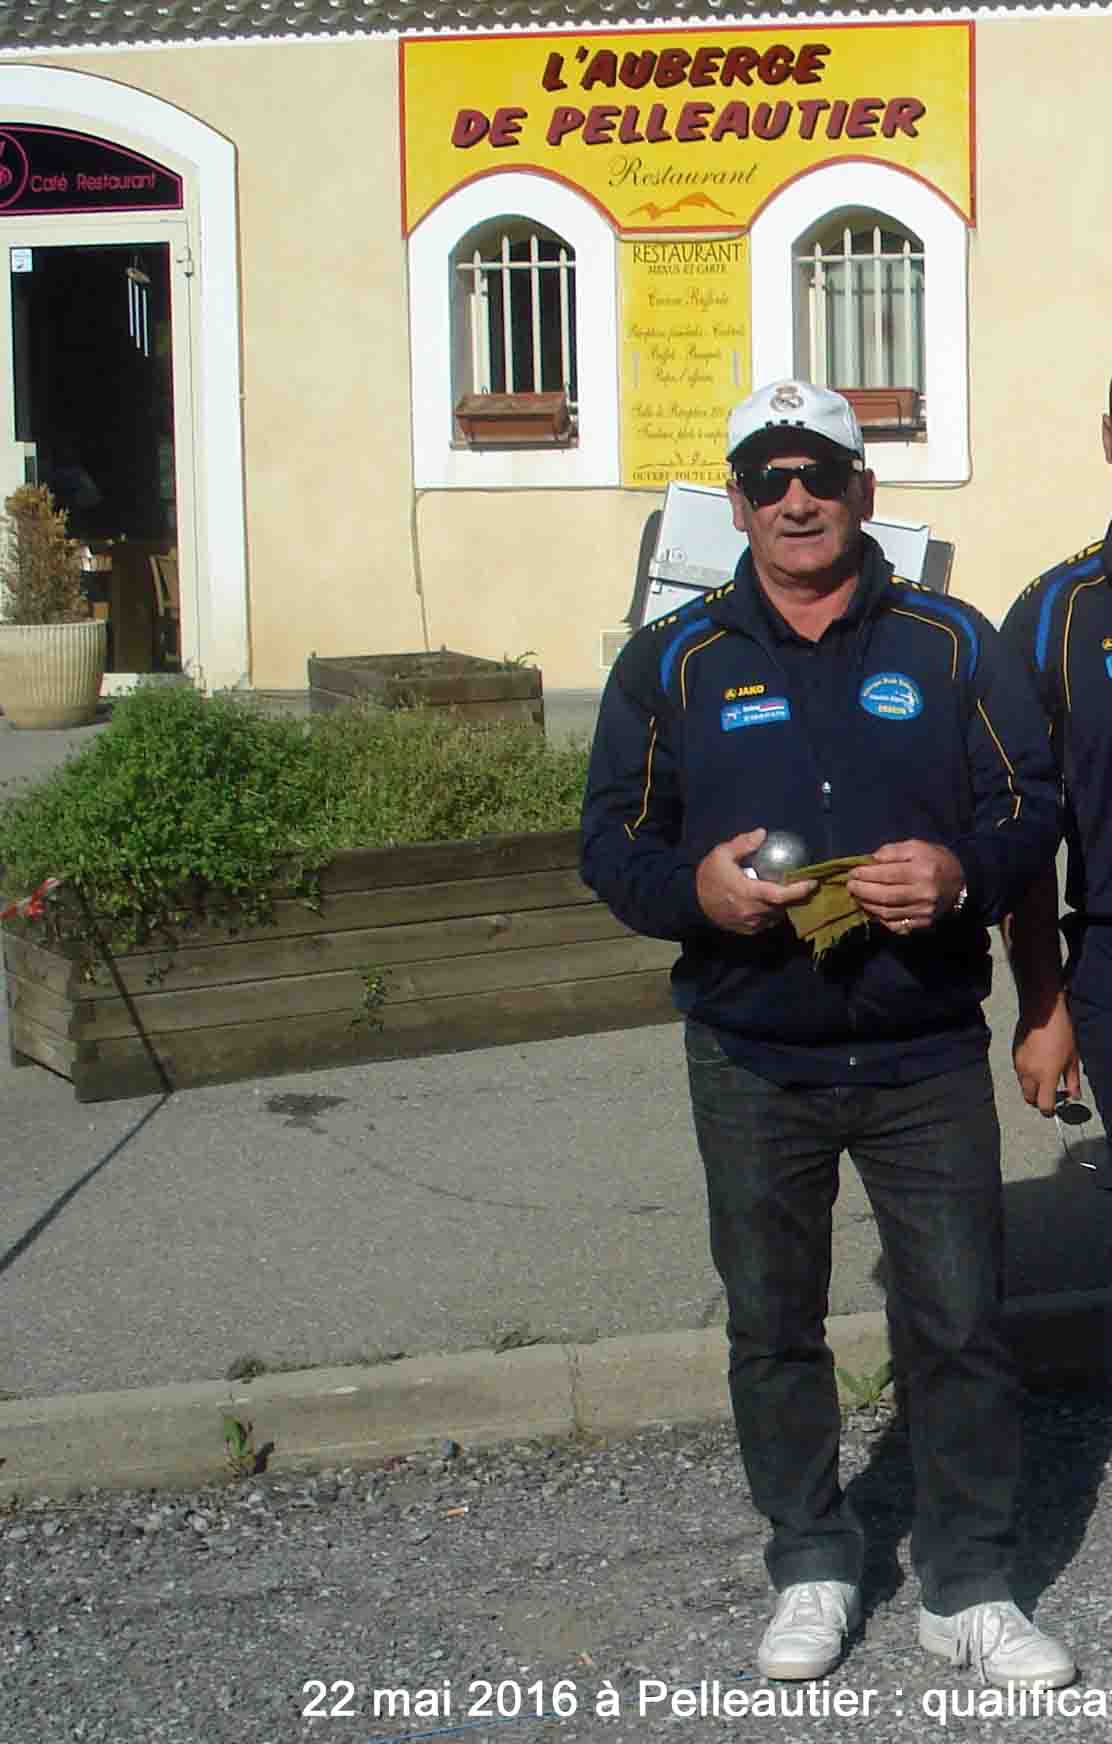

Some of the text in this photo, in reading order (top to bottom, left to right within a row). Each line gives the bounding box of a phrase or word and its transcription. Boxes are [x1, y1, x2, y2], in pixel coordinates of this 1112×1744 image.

[541, 43, 831, 92] L'AUBERGE
[451, 96, 926, 149] DE PELLEAUTIER
[31, 171, 156, 193] Café Restaurant
[607, 154, 761, 189] Restaurant
[632, 243, 743, 264] RESTAURANT
[738, 684, 765, 697] JAKO
